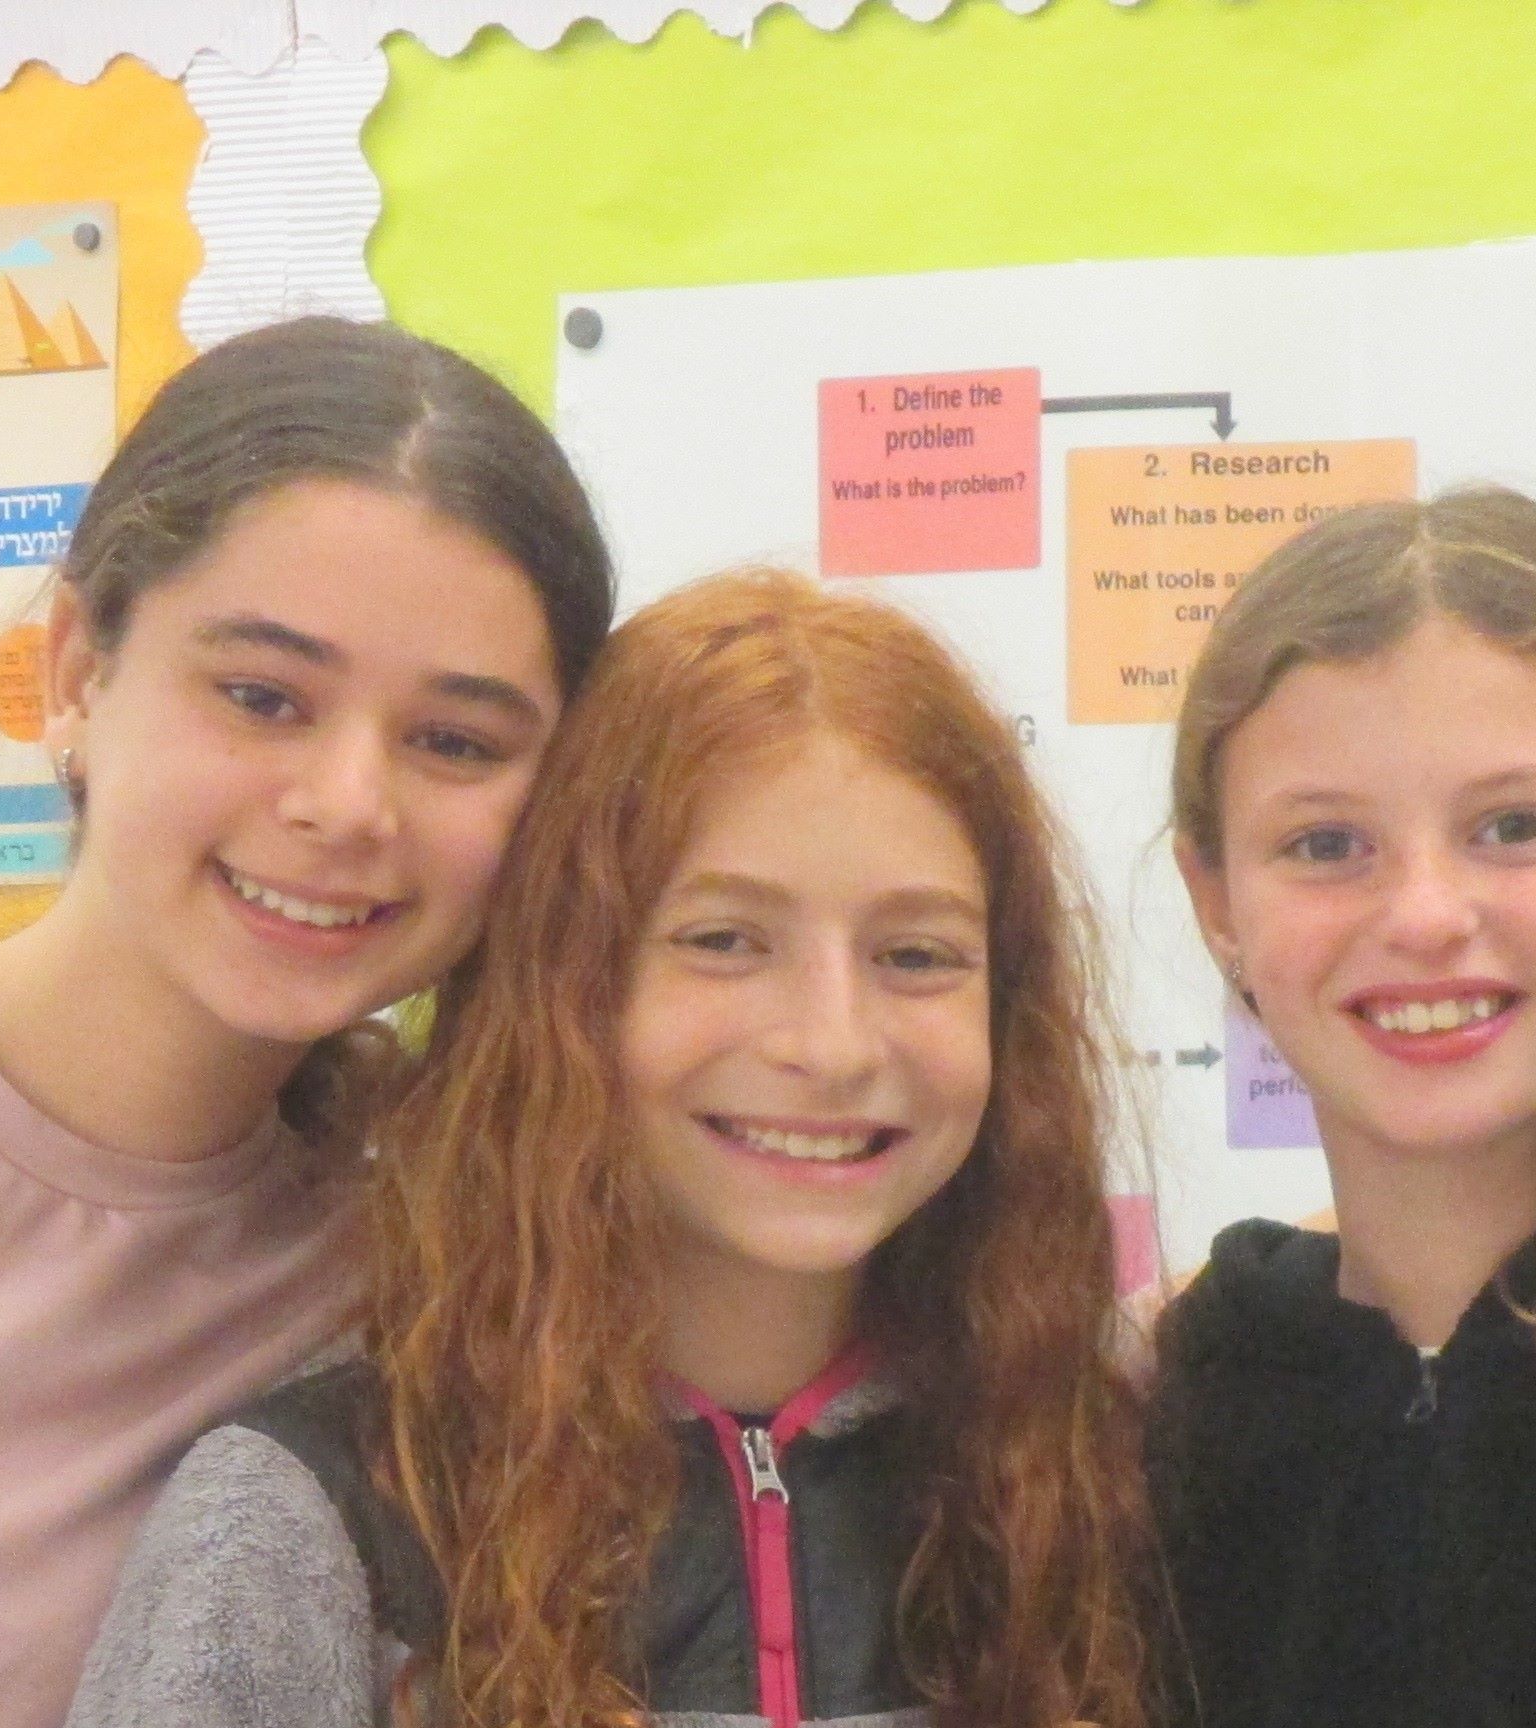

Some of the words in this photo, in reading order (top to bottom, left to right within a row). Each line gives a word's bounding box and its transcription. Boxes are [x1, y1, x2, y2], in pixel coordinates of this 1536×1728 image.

[892, 384, 963, 412] Define
[969, 382, 1003, 407] the
[884, 422, 975, 458] problem
[1143, 453, 1168, 477] 2.
[1190, 448, 1331, 477] Research
[831, 478, 882, 501] What
[886, 478, 902, 498] is
[907, 475, 936, 497] the
[940, 470, 1026, 501] problem?
[1109, 504, 1167, 527] What
[1174, 504, 1217, 525] has
[1225, 502, 1286, 525] been
[1092, 569, 1149, 592] What
[1156, 568, 1217, 590] tools
[1119, 664, 1178, 687] What
